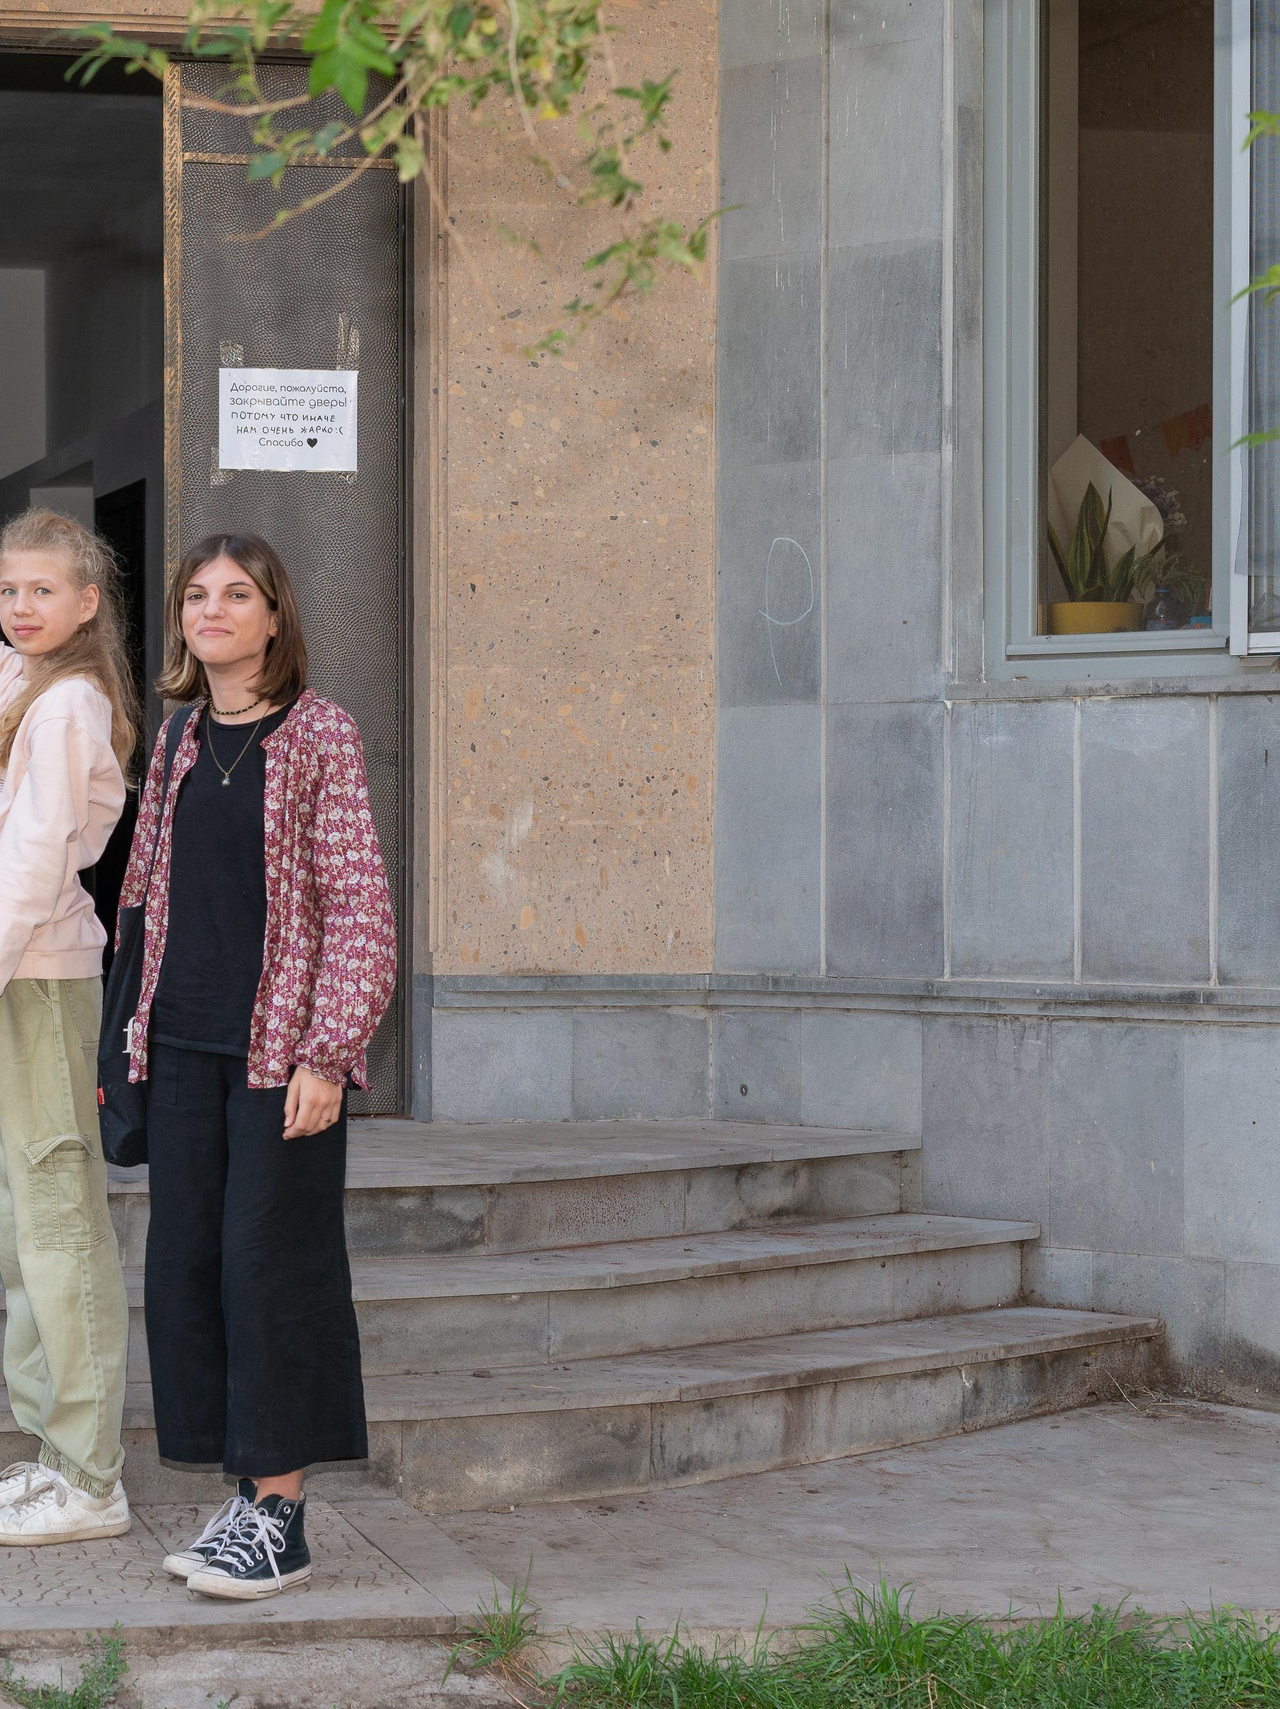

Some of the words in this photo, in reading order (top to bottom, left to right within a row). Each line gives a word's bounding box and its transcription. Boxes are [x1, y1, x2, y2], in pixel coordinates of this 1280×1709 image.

[229, 382, 277, 393] Дорогие,
[279, 384, 346, 395] пожалуйста,
[229, 396, 305, 408] закрывайте
[308, 397, 347, 409] дверь!
[231, 411, 276, 420] ПОТОМУ
[280, 413, 299, 422] ЧТО
[302, 414, 336, 423] ИНАЧЕ
[236, 425, 257, 435] НАМ
[262, 426, 295, 435] ОЧЕНЬ
[258, 437, 304, 447] Спасибо
